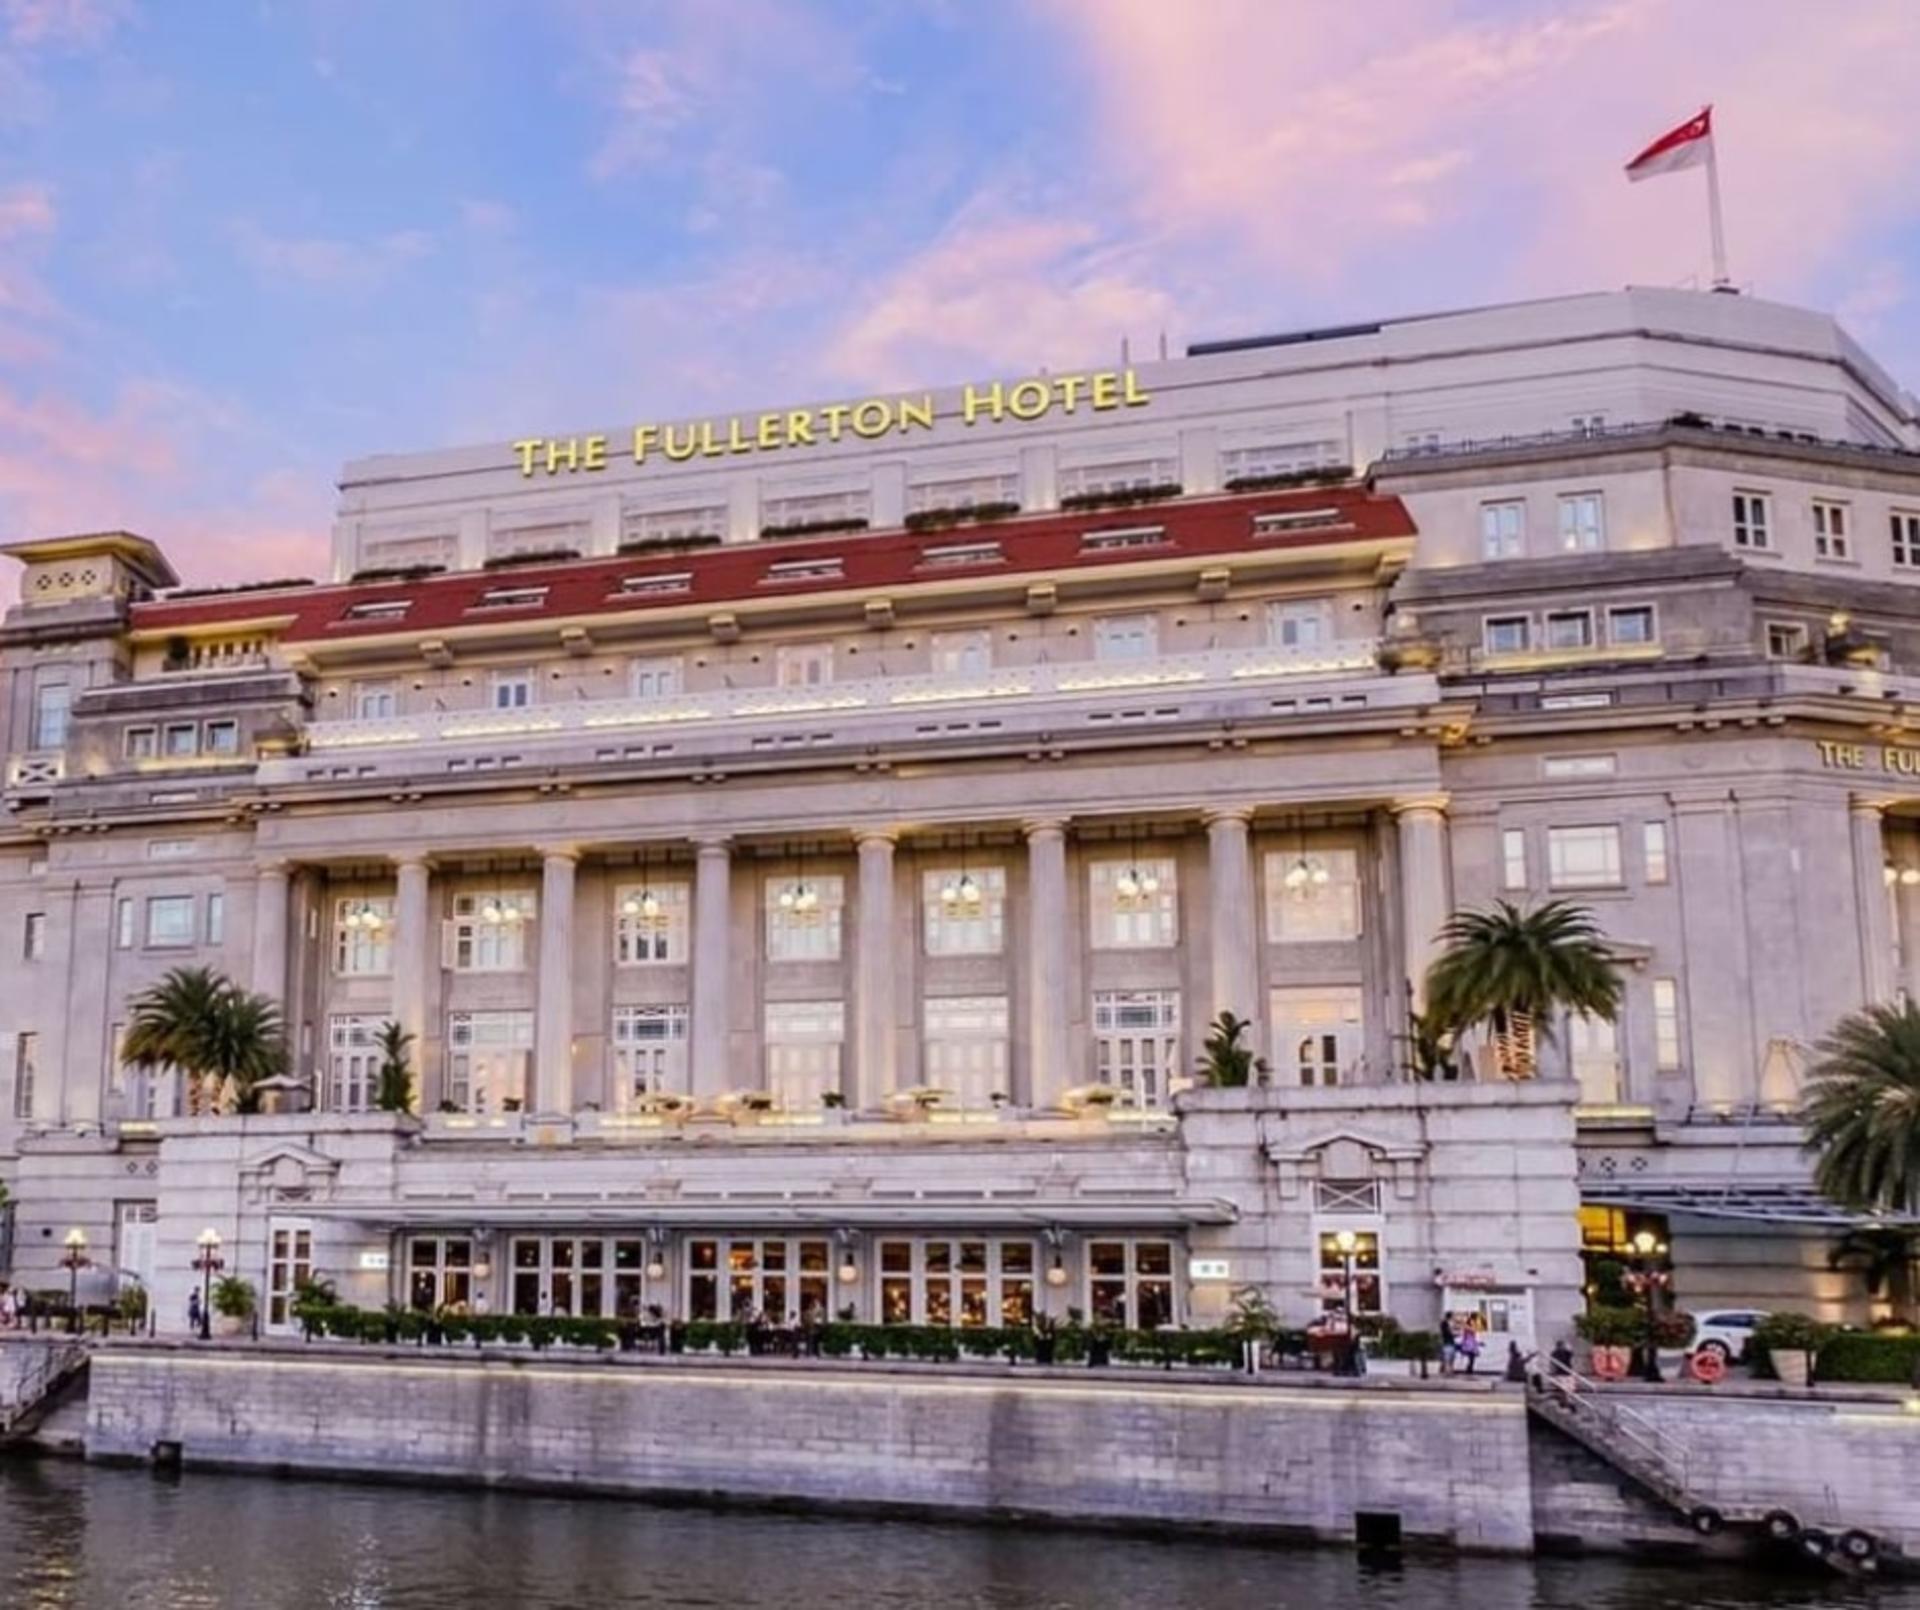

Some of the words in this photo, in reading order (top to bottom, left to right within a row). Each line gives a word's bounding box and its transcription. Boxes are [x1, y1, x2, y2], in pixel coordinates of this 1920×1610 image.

[513, 435, 606, 477] THE
[633, 394, 933, 464] FULLERTON
[962, 369, 1149, 426] HOTEL
[1817, 740, 1864, 769] THE
